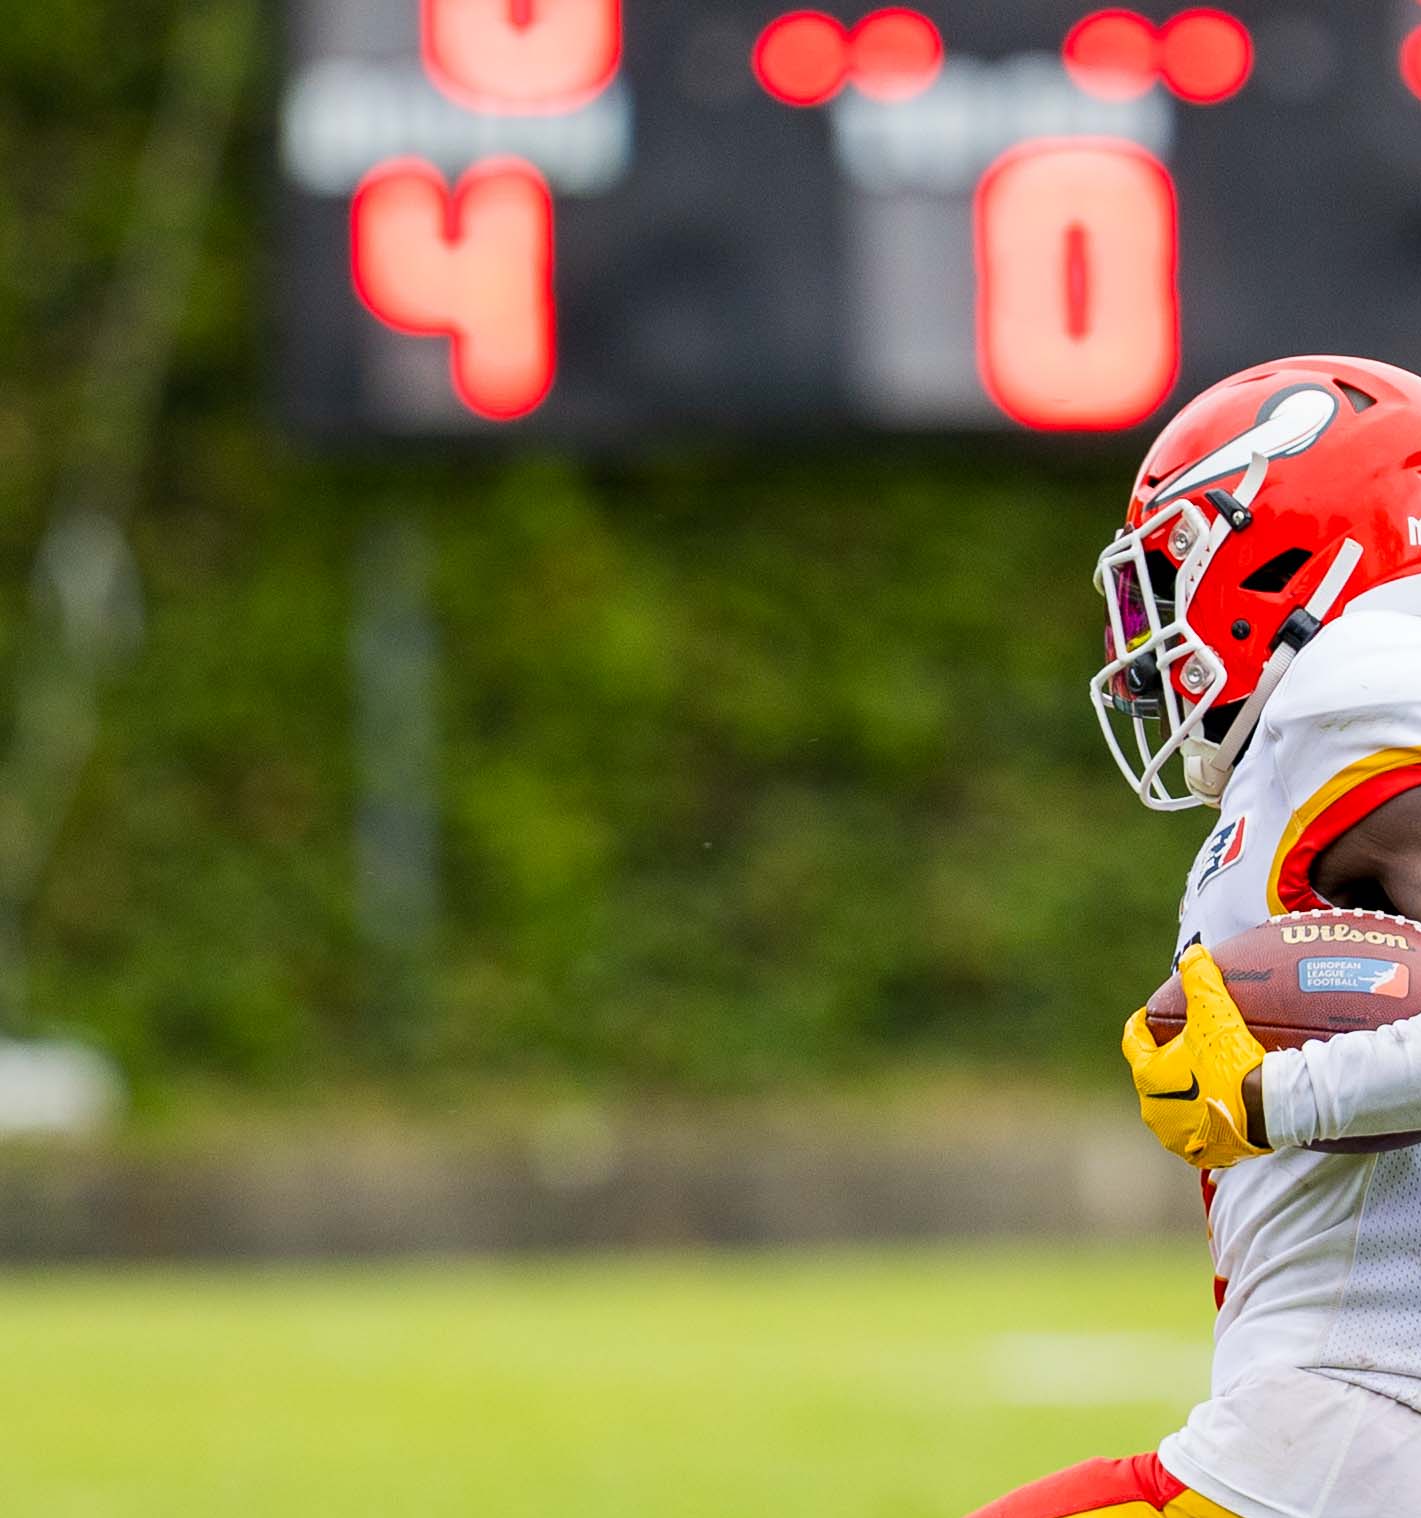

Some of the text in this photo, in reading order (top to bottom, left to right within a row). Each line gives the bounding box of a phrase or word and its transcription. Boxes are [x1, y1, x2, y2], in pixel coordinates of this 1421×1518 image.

[350, 154, 557, 422] 4
[973, 136, 1180, 430] 0
[1280, 923, 1409, 951] Wilson
[1306, 961, 1361, 971] EUROPEAN
[1307, 969, 1345, 979] LEAGUE
[1307, 978, 1359, 987] FOOTBALL
